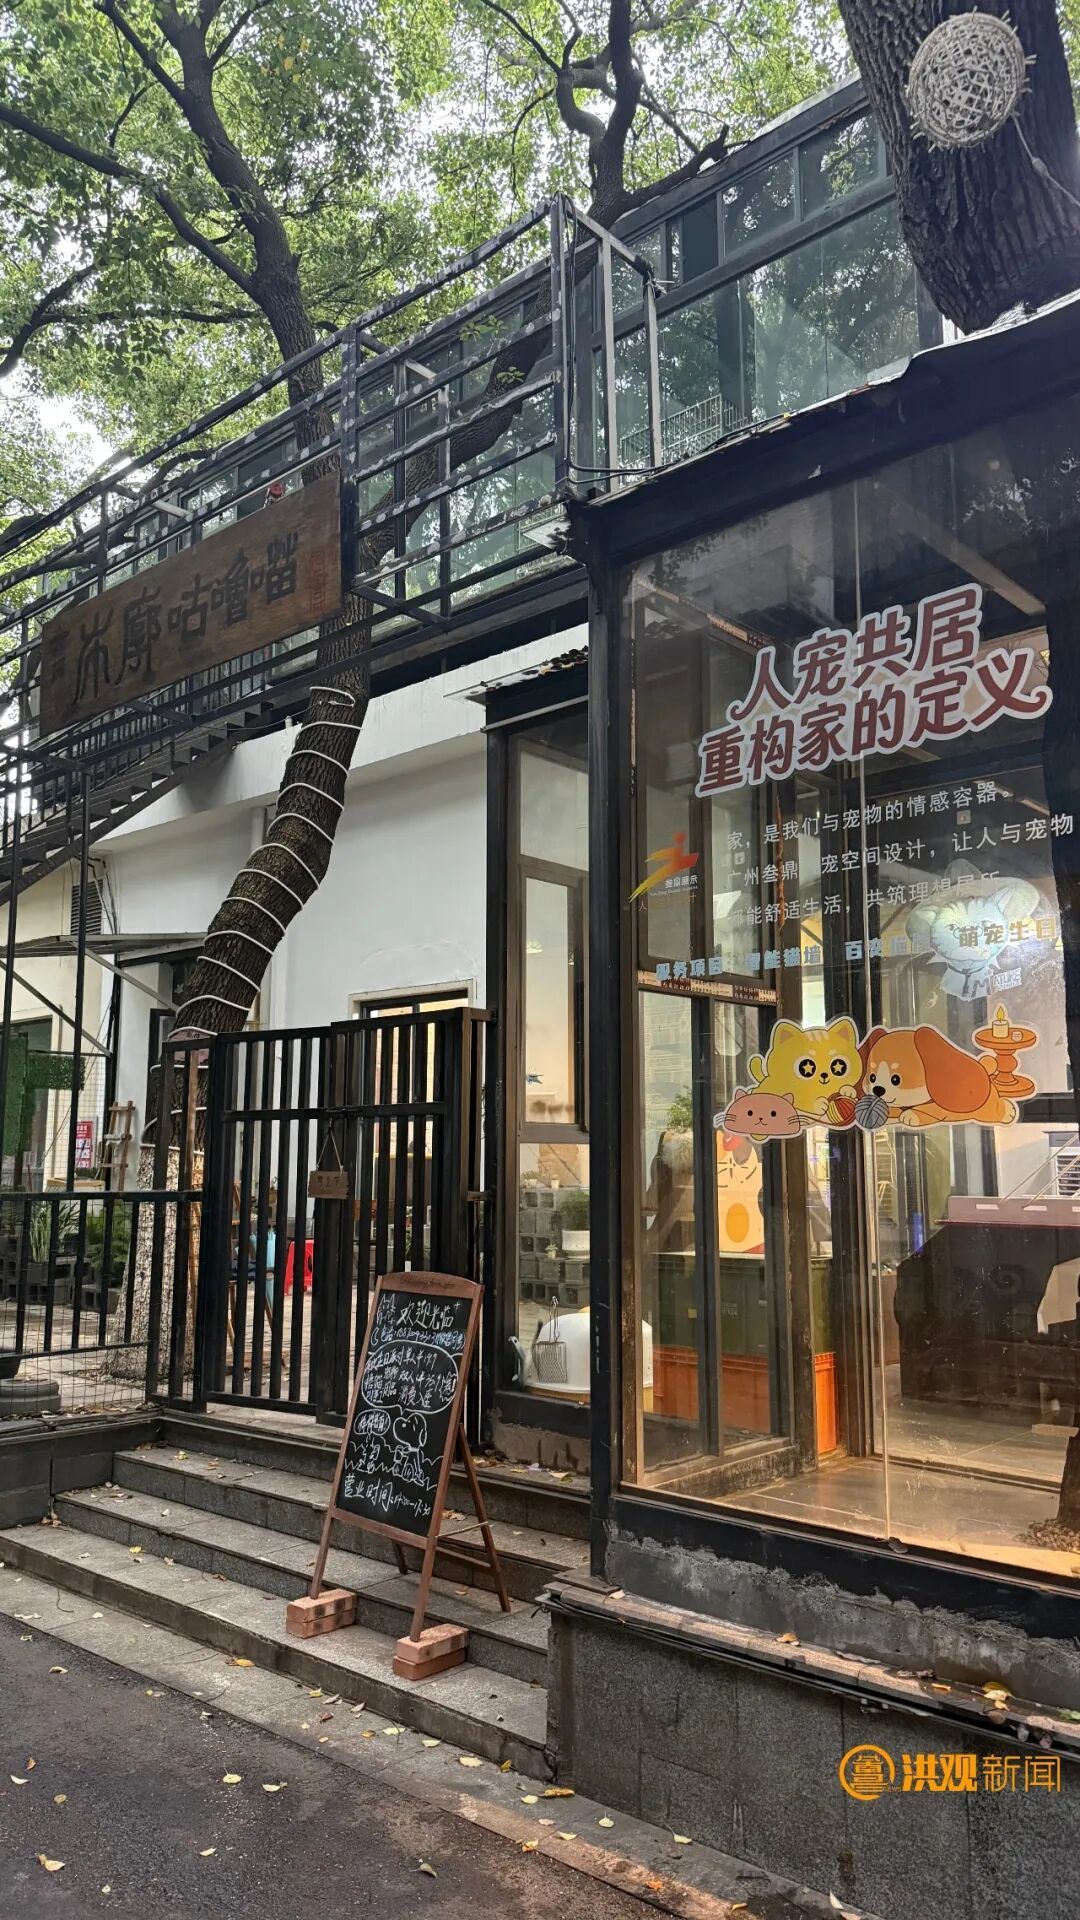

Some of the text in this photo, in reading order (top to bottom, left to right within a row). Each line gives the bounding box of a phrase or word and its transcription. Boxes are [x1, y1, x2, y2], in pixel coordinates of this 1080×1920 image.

[729, 586, 981, 720] 人宠共居
[697, 650, 1052, 796] 重构家的定义
[396, 1299, 455, 1331] 欢迎光临
